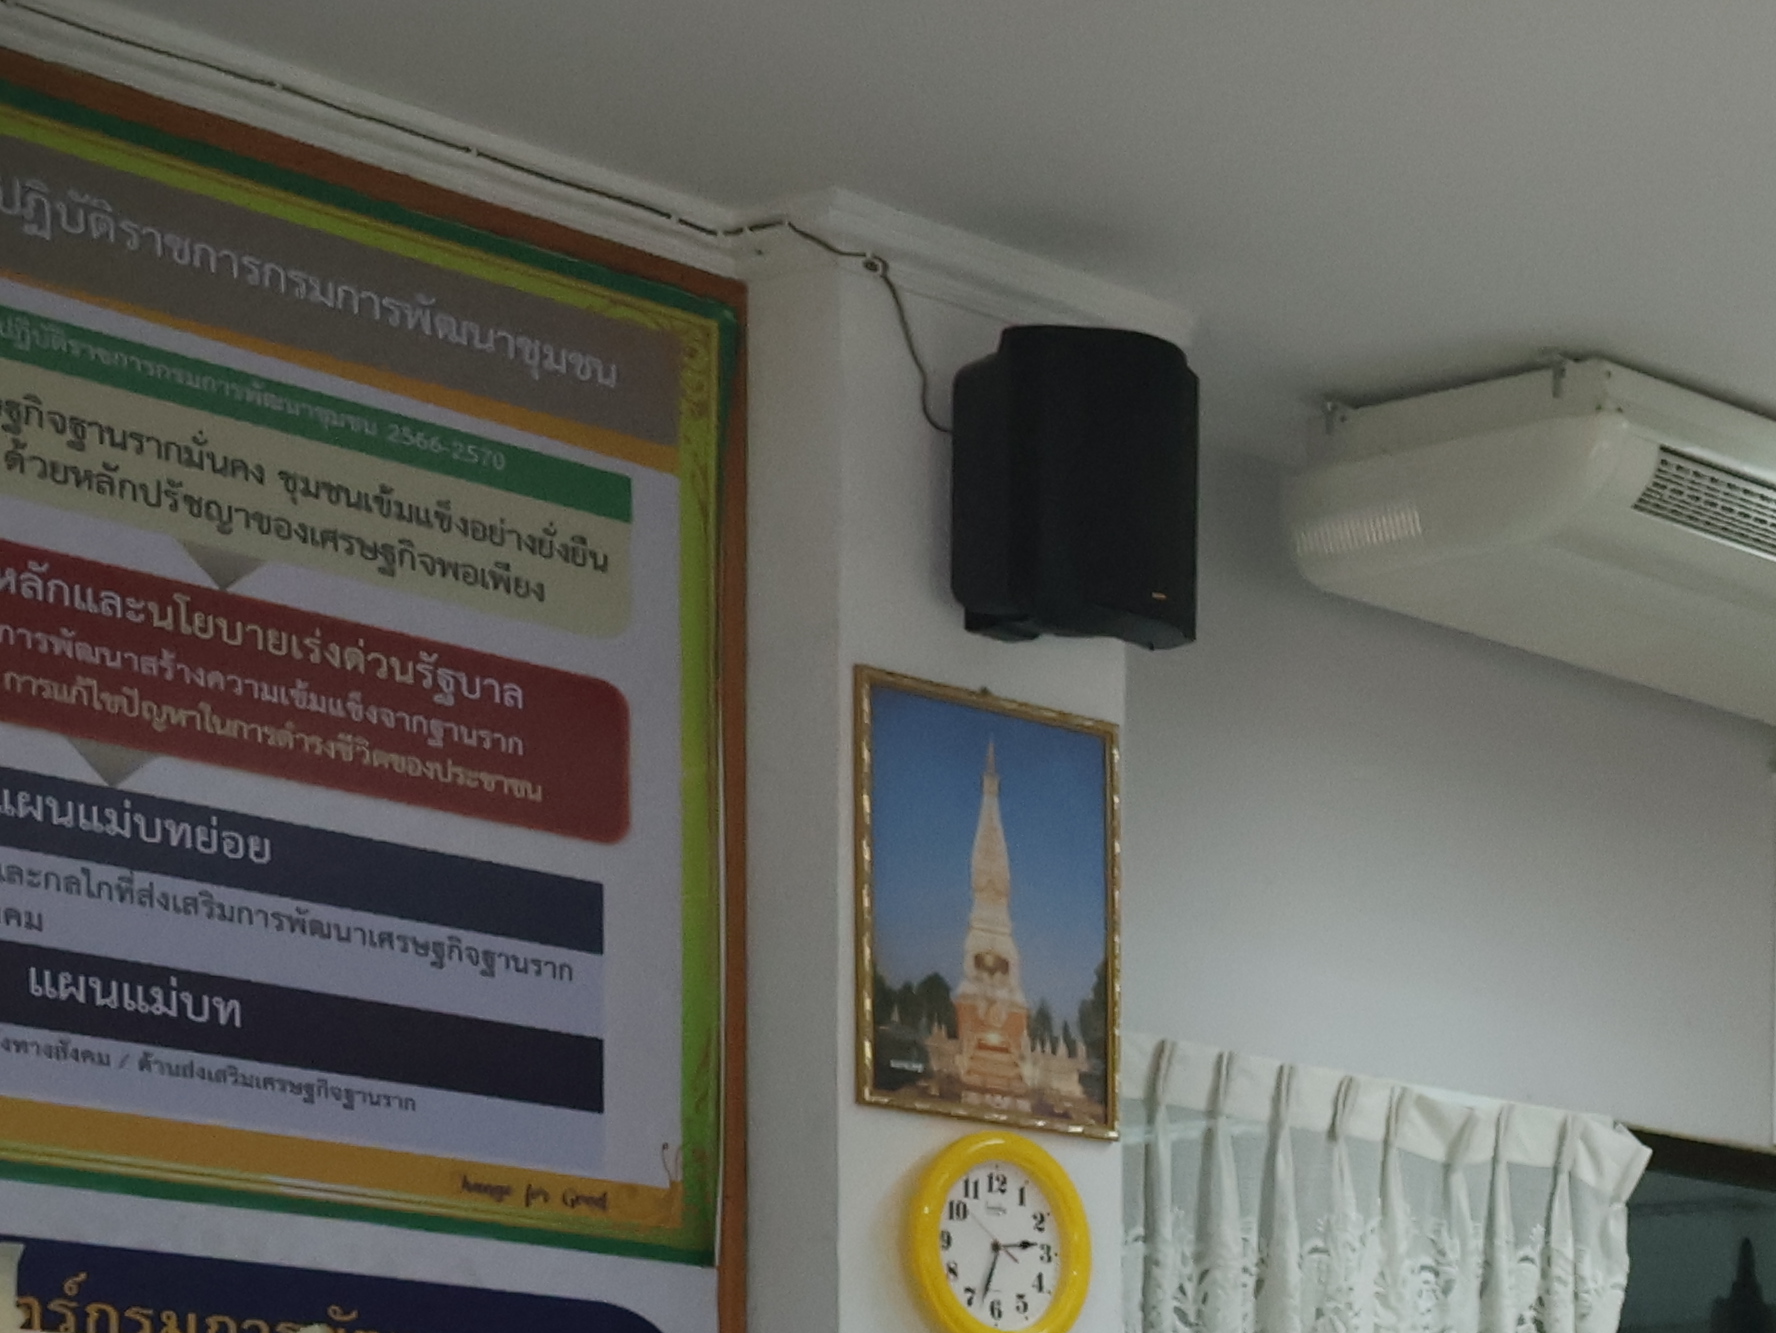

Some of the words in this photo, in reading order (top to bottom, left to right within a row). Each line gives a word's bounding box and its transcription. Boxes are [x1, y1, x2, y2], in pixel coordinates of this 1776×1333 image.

[387, 423, 507, 471] 2566-2570
[28, 966, 242, 1028] แผนแม่บท
[963, 1177, 979, 1200] 11
[987, 1171, 1007, 1194] 12
[1018, 1186, 1026, 1207] 1
[948, 1201, 968, 1220] 10
[1032, 1211, 1046, 1232] 2
[940, 1230, 951, 1250] 9
[1039, 1243, 1052, 1263] 3
[1032, 1272, 1045, 1293] 4
[964, 1286, 976, 1307] 7
[1015, 1293, 1028, 1314] 5
[989, 1299, 1003, 1320] 6
